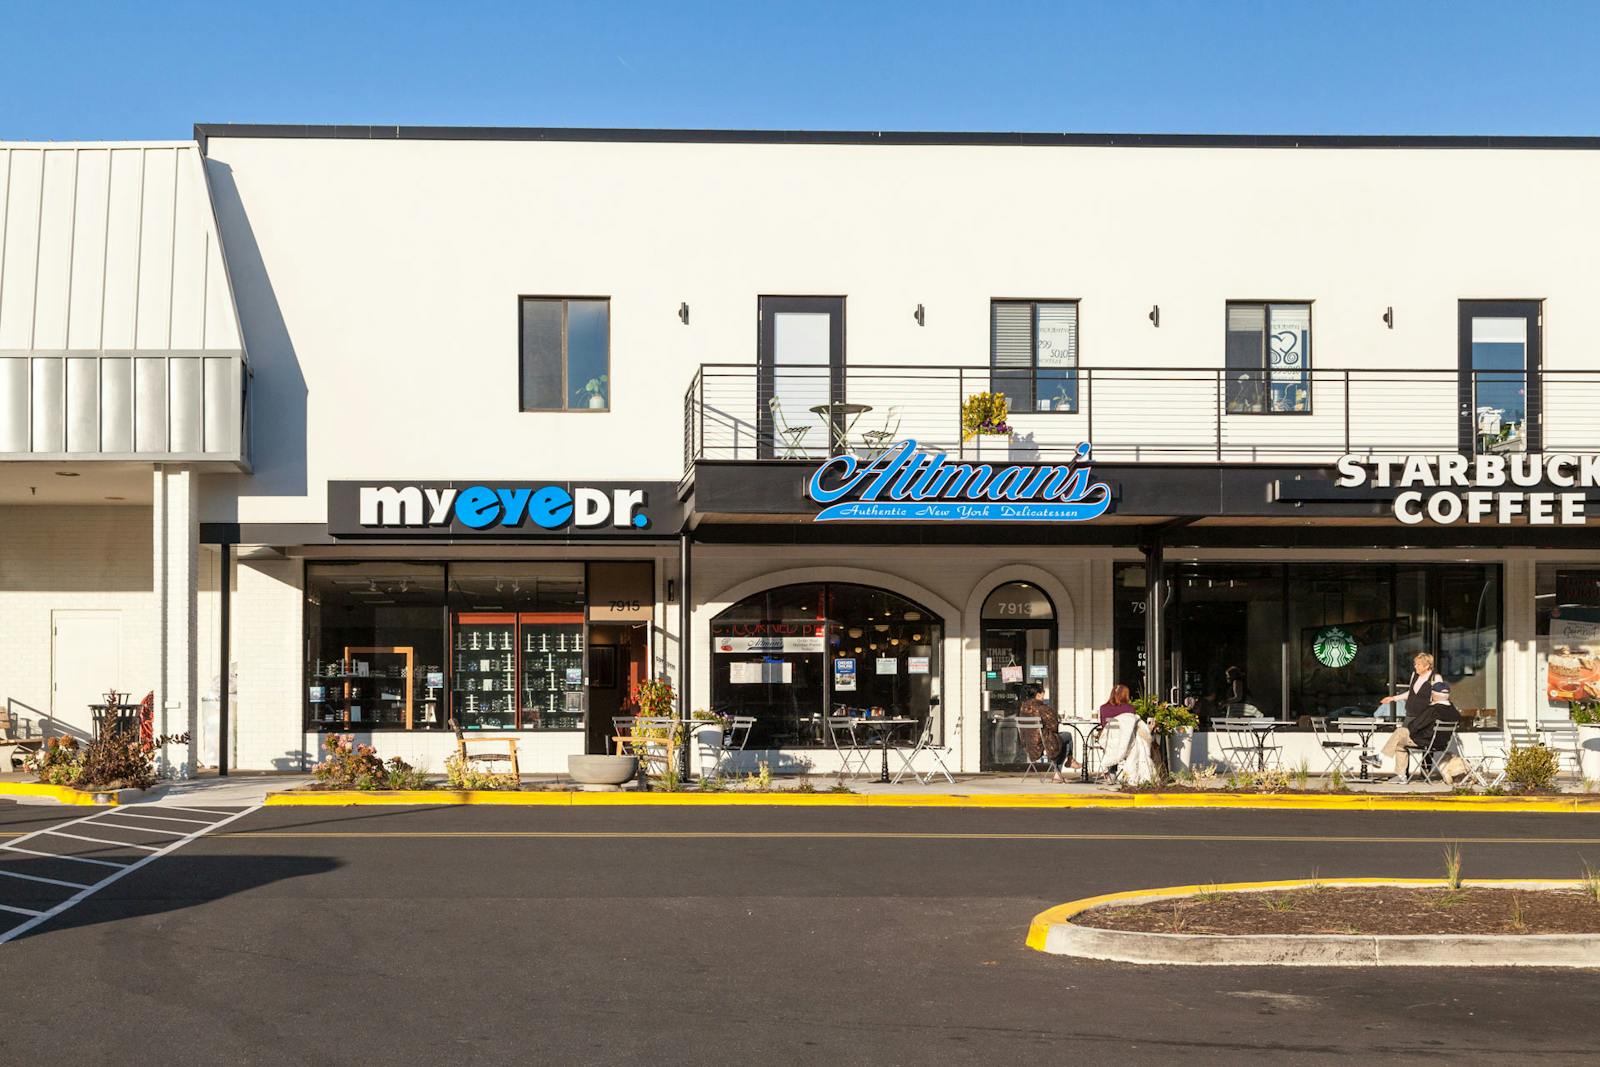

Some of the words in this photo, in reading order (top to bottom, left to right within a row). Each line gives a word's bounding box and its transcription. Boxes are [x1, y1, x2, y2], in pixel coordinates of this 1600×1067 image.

[809, 439, 1092, 502] Attman's
[840, 505, 907, 517] Authentic
[915, 506, 950, 517] New
[956, 505, 990, 518] York
[1001, 506, 1078, 517] Delicatessen
[1394, 491, 1586, 524] COFFEE
[608, 600, 640, 611] 7915
[998, 602, 1033, 615] 7913
